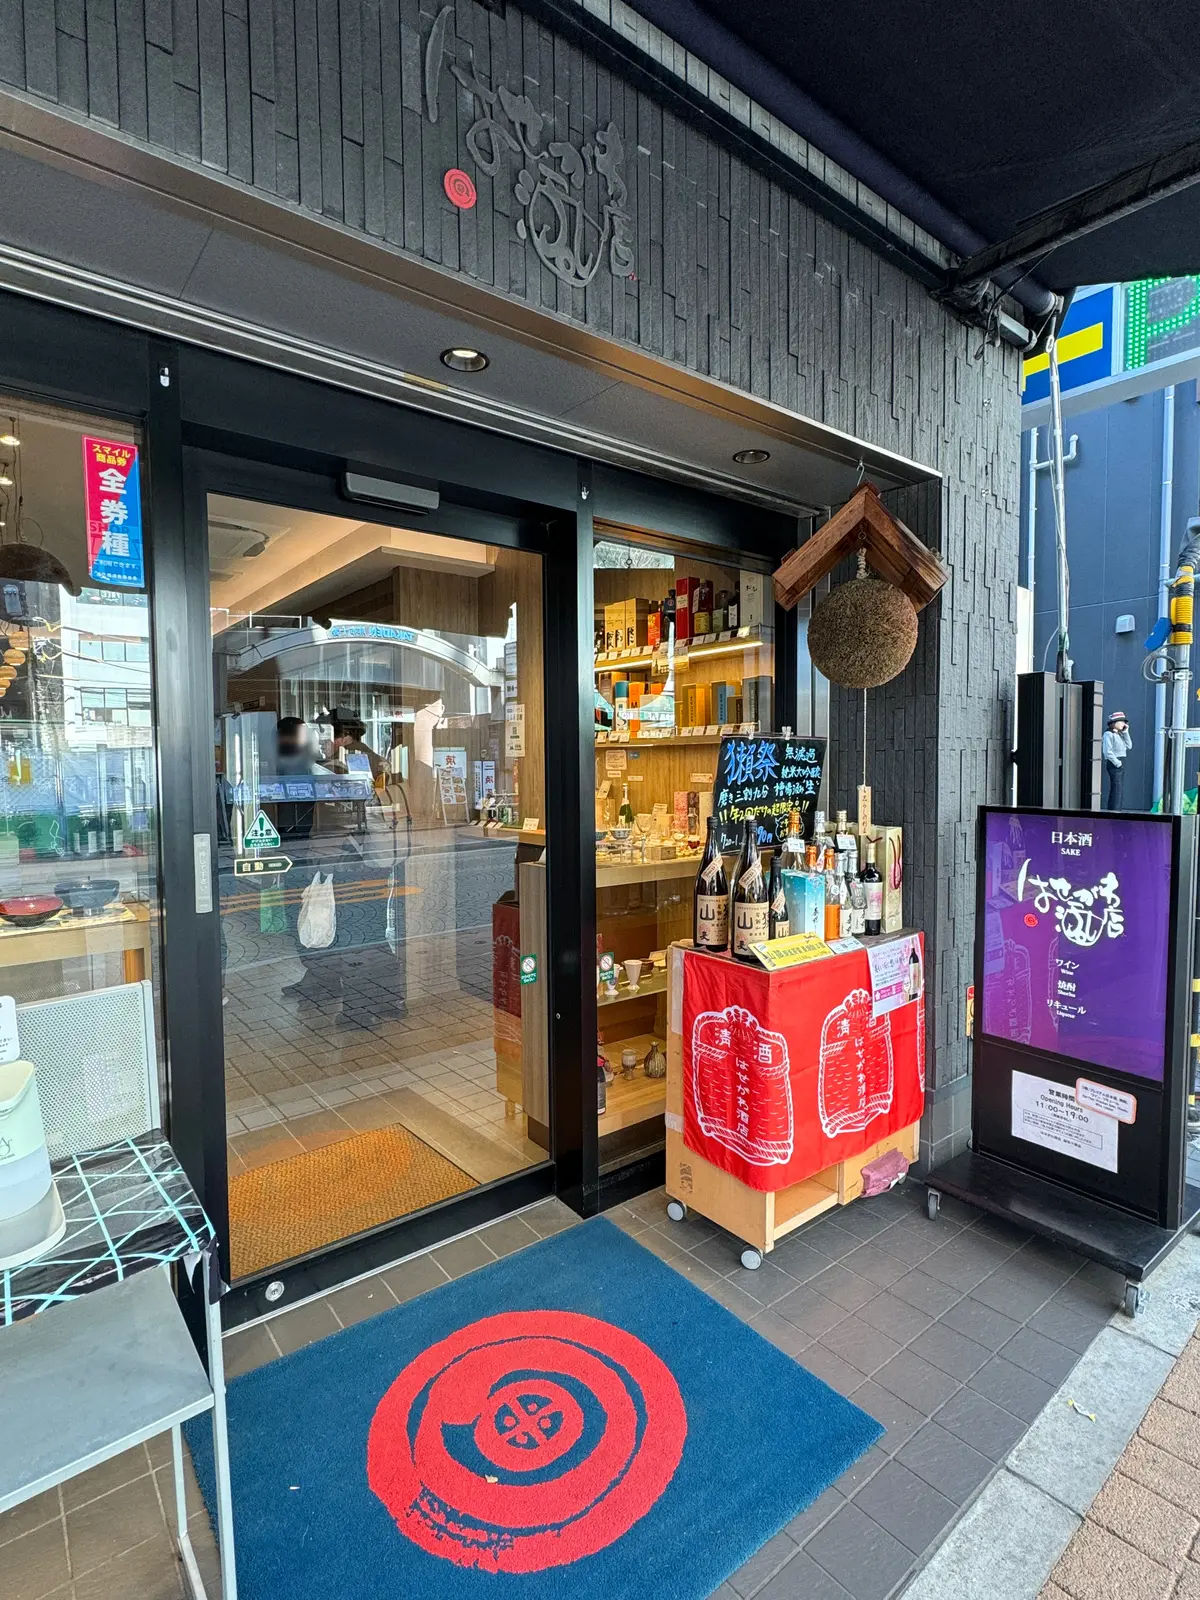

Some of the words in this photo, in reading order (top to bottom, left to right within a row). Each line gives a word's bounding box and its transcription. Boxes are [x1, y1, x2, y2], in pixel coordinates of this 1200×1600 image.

[92, 444, 131, 459] スマイル
[95, 453, 127, 467] 商品券
[98, 468, 130, 556] 全券種
[1051, 831, 1093, 847] 日本酒
[1061, 848, 1081, 856] SAKE
[242, 861, 264, 872] 自動
[1056, 959, 1080, 970] ワイン
[1057, 980, 1076, 992] 焼酎
[1047, 999, 1087, 1015] リキュール
[735, 1057, 750, 1137] はせがわ酒店
[1048, 1088, 1076, 1103] 営業時間
[1040, 1094, 1064, 1108] Opening
[1065, 1102, 1083, 1113] Hours
